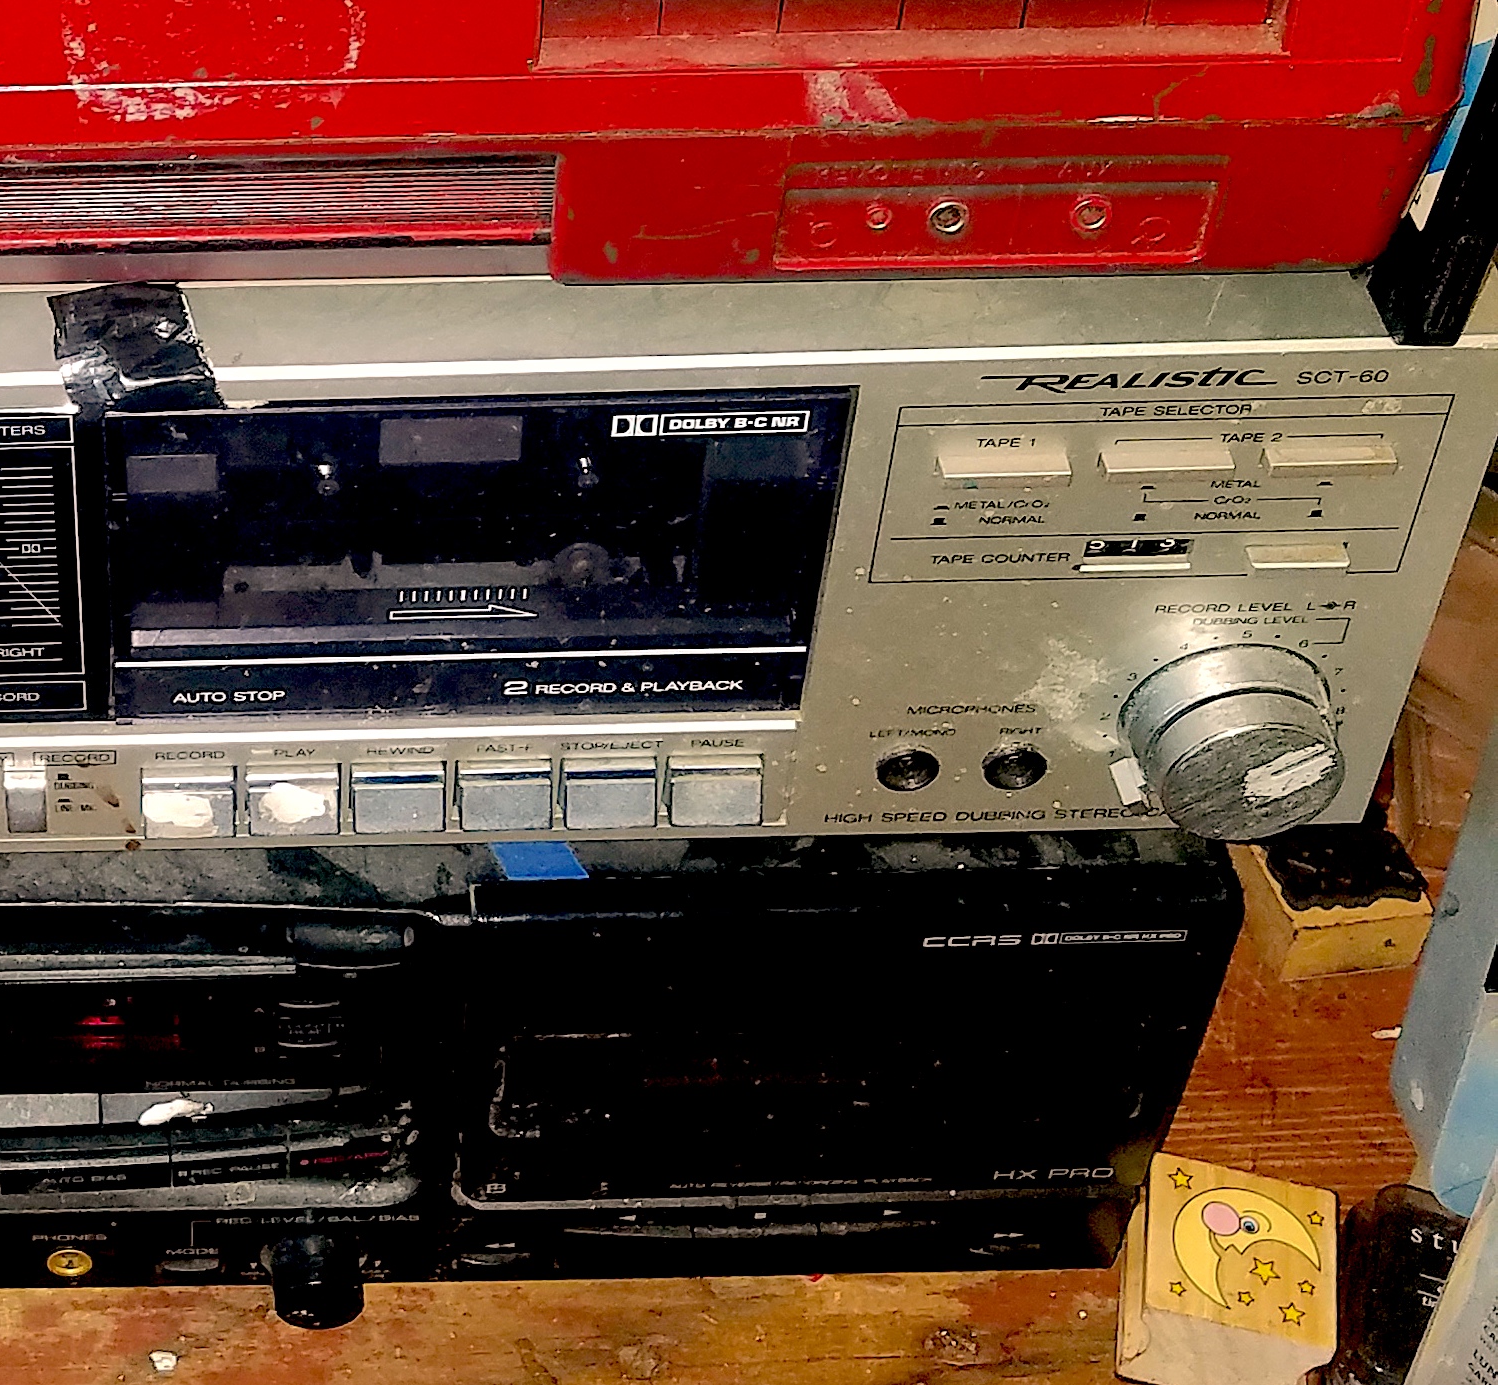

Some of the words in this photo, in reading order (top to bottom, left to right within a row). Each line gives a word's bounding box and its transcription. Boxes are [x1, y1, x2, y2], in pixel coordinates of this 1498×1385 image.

[981, 368, 1278, 393] REALISTIC
[1296, 370, 1390, 384] SCT-60
[1099, 404, 1146, 417] TAPE
[1152, 403, 1253, 416] SELECTOR
[669, 417, 728, 429] DOLBY
[771, 415, 800, 428] NR
[976, 437, 1021, 448] TAPE
[1029, 437, 1037, 448] 1
[1219, 432, 1266, 444] TAPE
[1271, 432, 1283, 443] 2
[979, 515, 1046, 525] NORMAL
[1193, 510, 1262, 521] NORMAL
[931, 554, 975, 565] TAPE
[981, 552, 1071, 564] COUNTER
[1155, 603, 1231, 614] RECORD
[1238, 601, 1292, 612] LEVEL
[1264, 616, 1309, 625] LEVEL
[1241, 630, 1253, 639] 5
[504, 680, 528, 696] 2
[534, 683, 618, 695] RECORD
[621, 682, 637, 695] &
[640, 679, 744, 694] PLAYBACK
[172, 692, 229, 704] AUTO
[234, 690, 287, 703] STOP
[906, 703, 1036, 715] MICROPHONES
[560, 739, 664, 751] STOP/EJECT
[690, 737, 745, 748] PAUSE
[155, 750, 225, 760] RECORD
[274, 748, 315, 758] PLAY
[366, 745, 435, 756] REWIND
[40, 753, 111, 763] RECORD
[824, 813, 872, 823] HIGH
[882, 811, 948, 823] SPEED
[955, 809, 1046, 821] DUBBING
[993, 1169, 1039, 1180] HX
[1048, 1167, 1115, 1180] PRO
[32, 1233, 108, 1242] PHONES
